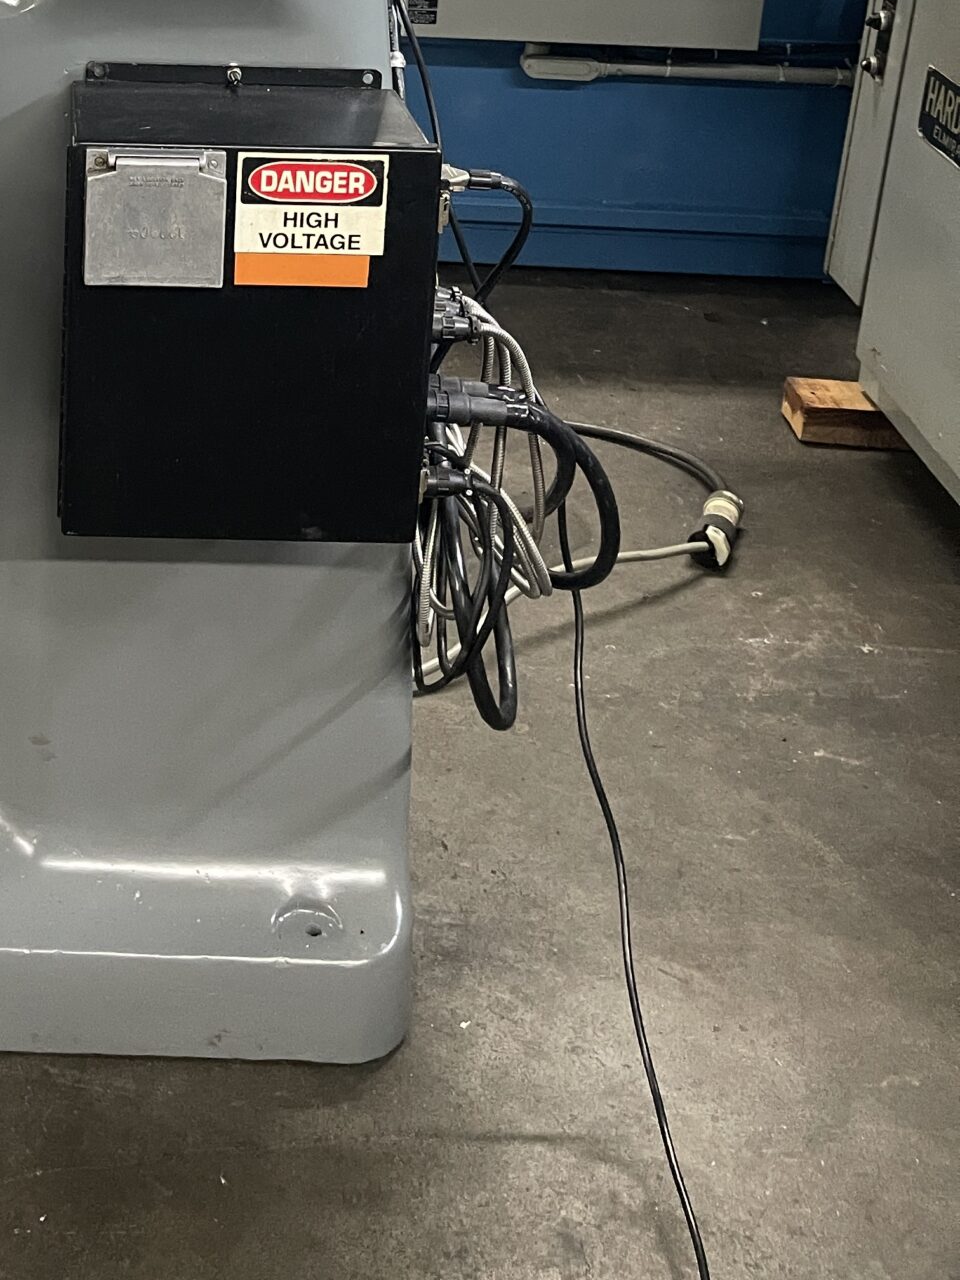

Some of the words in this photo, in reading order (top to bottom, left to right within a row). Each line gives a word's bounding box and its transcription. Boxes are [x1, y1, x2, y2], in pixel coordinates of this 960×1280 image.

[260, 170, 366, 195] DANGER
[283, 211, 339, 229] HIGH
[259, 232, 362, 251] VOLTAGE
